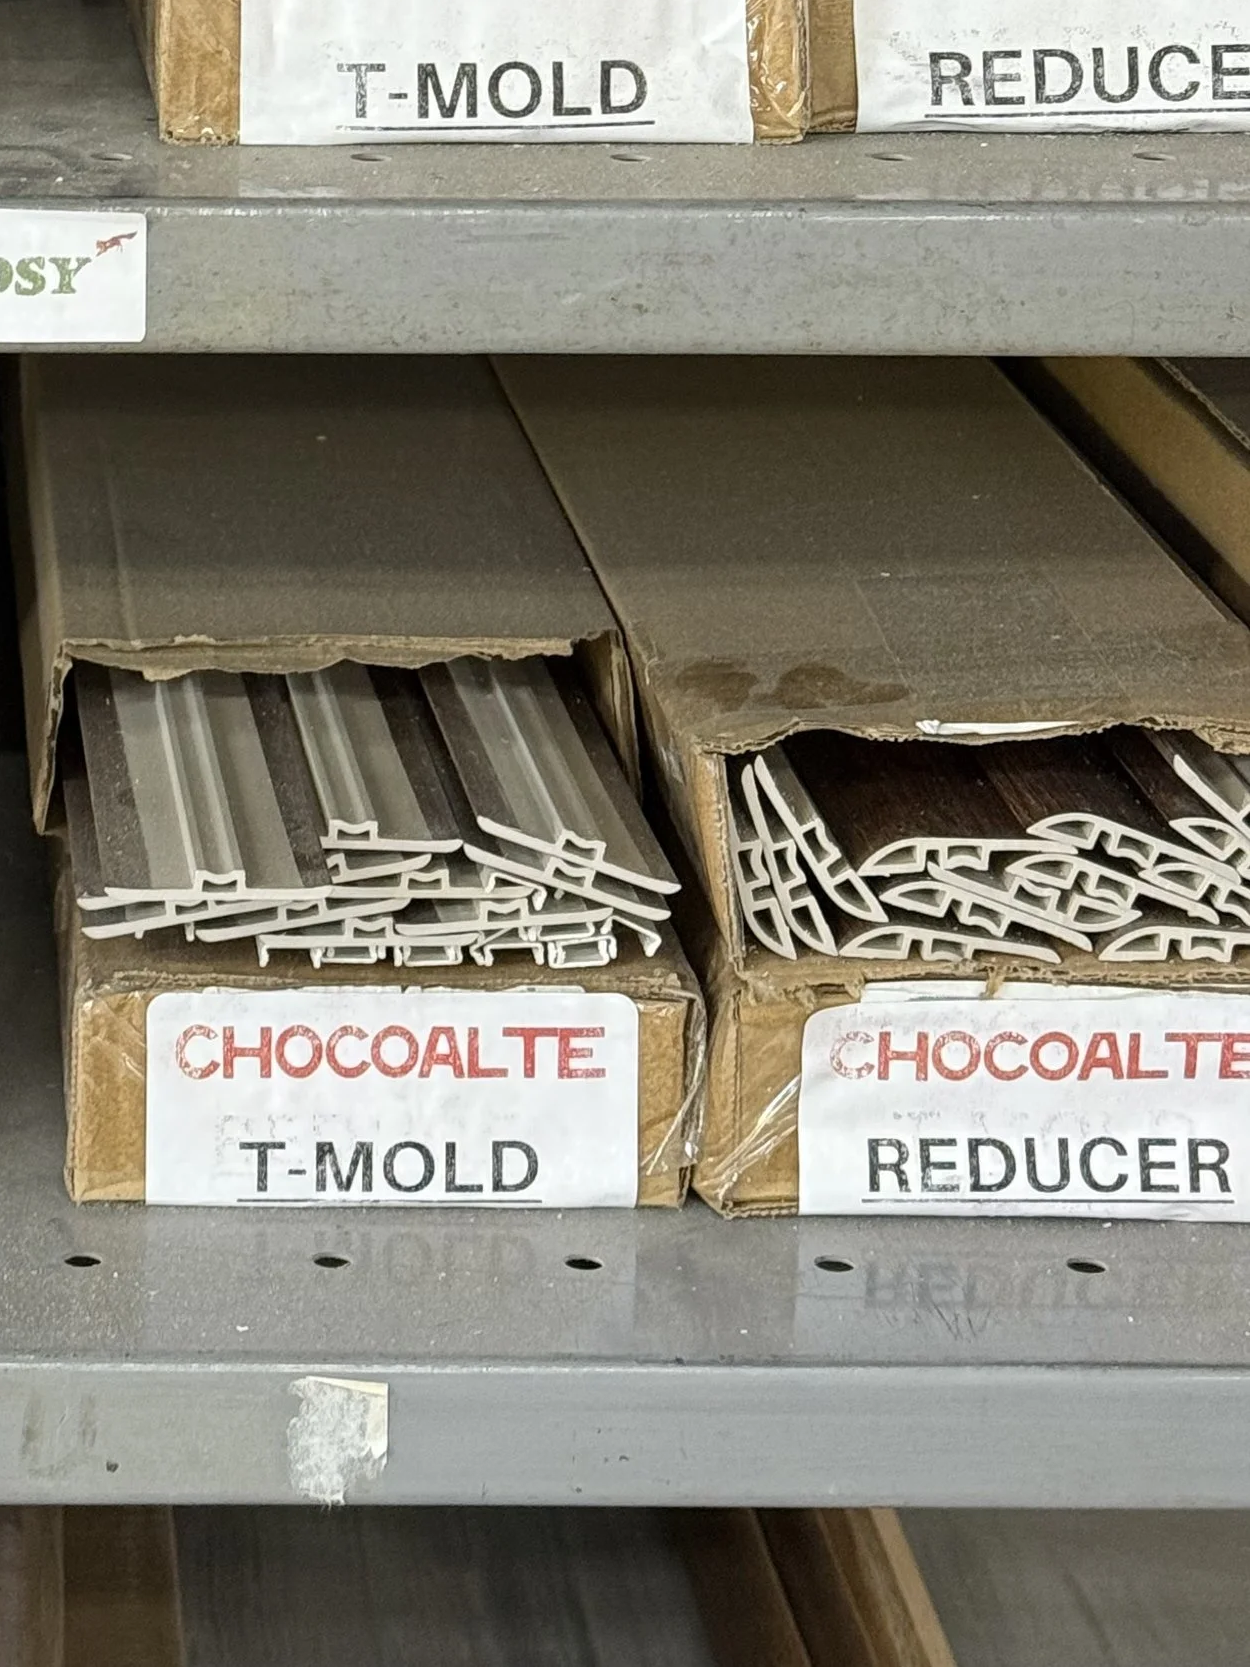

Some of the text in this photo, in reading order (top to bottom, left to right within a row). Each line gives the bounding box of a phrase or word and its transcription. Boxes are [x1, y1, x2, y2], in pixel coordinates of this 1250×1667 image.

[335, 59, 649, 120] T-MOLD
[928, 43, 1250, 107] REDUCE
[175, 1024, 608, 1080] CHOCOALTE
[238, 1140, 540, 1194] T-MOLD
[866, 1136, 1233, 1194] REDUCER
